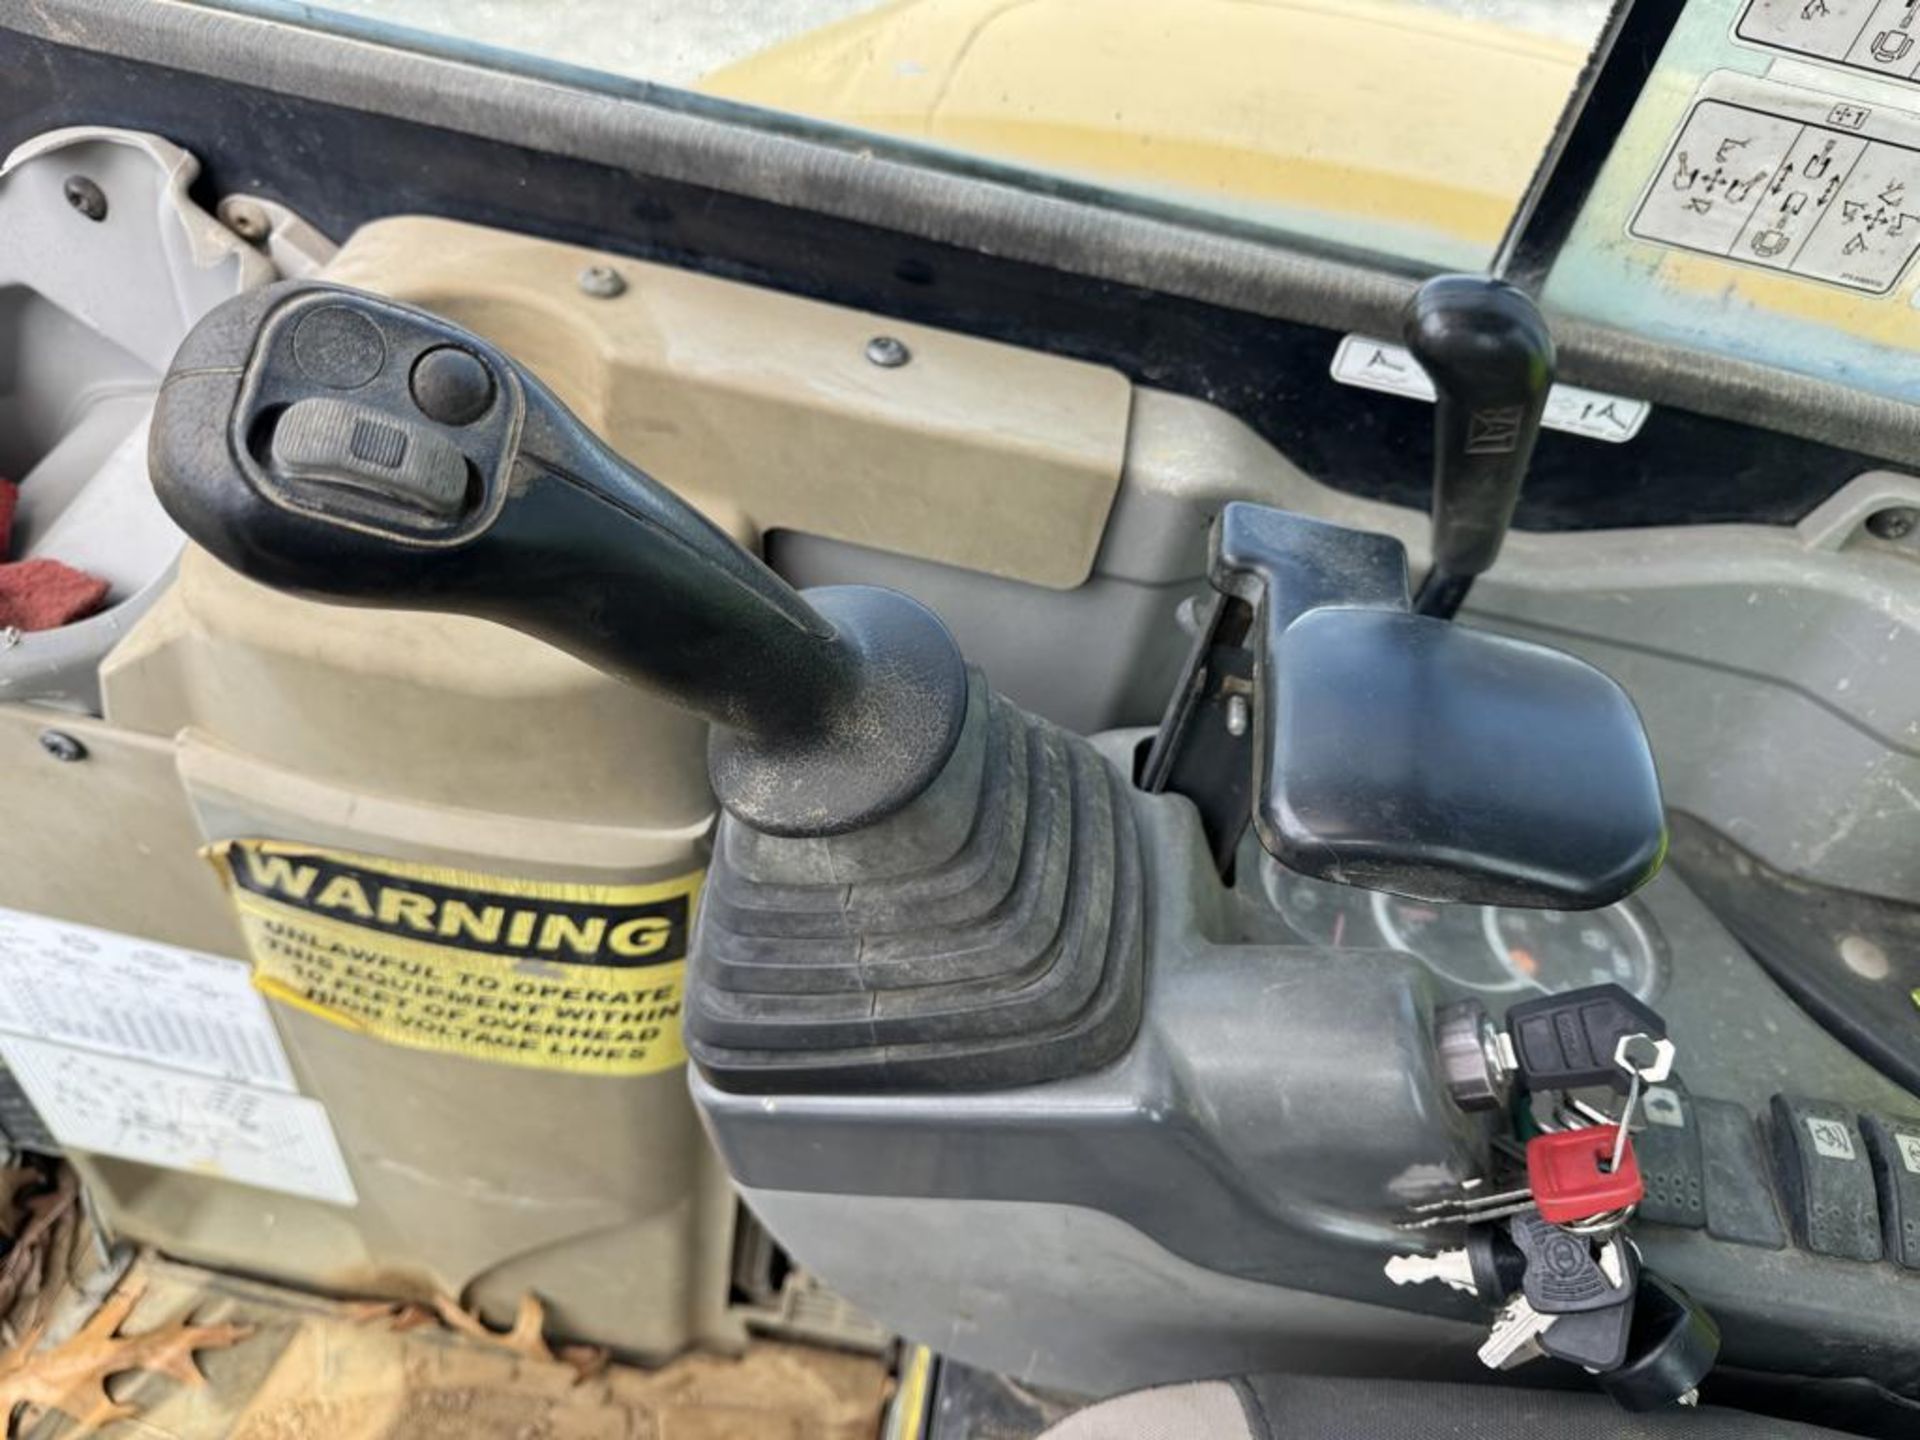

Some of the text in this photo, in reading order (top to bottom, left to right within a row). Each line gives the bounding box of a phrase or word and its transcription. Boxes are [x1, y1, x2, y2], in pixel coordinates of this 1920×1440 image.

[247, 853, 671, 956] WARNING
[264, 919, 675, 1004] UNLAWFUL TO OPERATE
[264, 936, 334, 970] THIS
[346, 965, 545, 1015] EQUIPMENT
[555, 1001, 681, 1022] WITHIN
[335, 977, 408, 1009] FEET
[423, 1002, 465, 1019] OF
[477, 1013, 661, 1043] OVERHEAD
[397, 1012, 538, 1050] VOLTAGE
[549, 1042, 647, 1061] LINES
